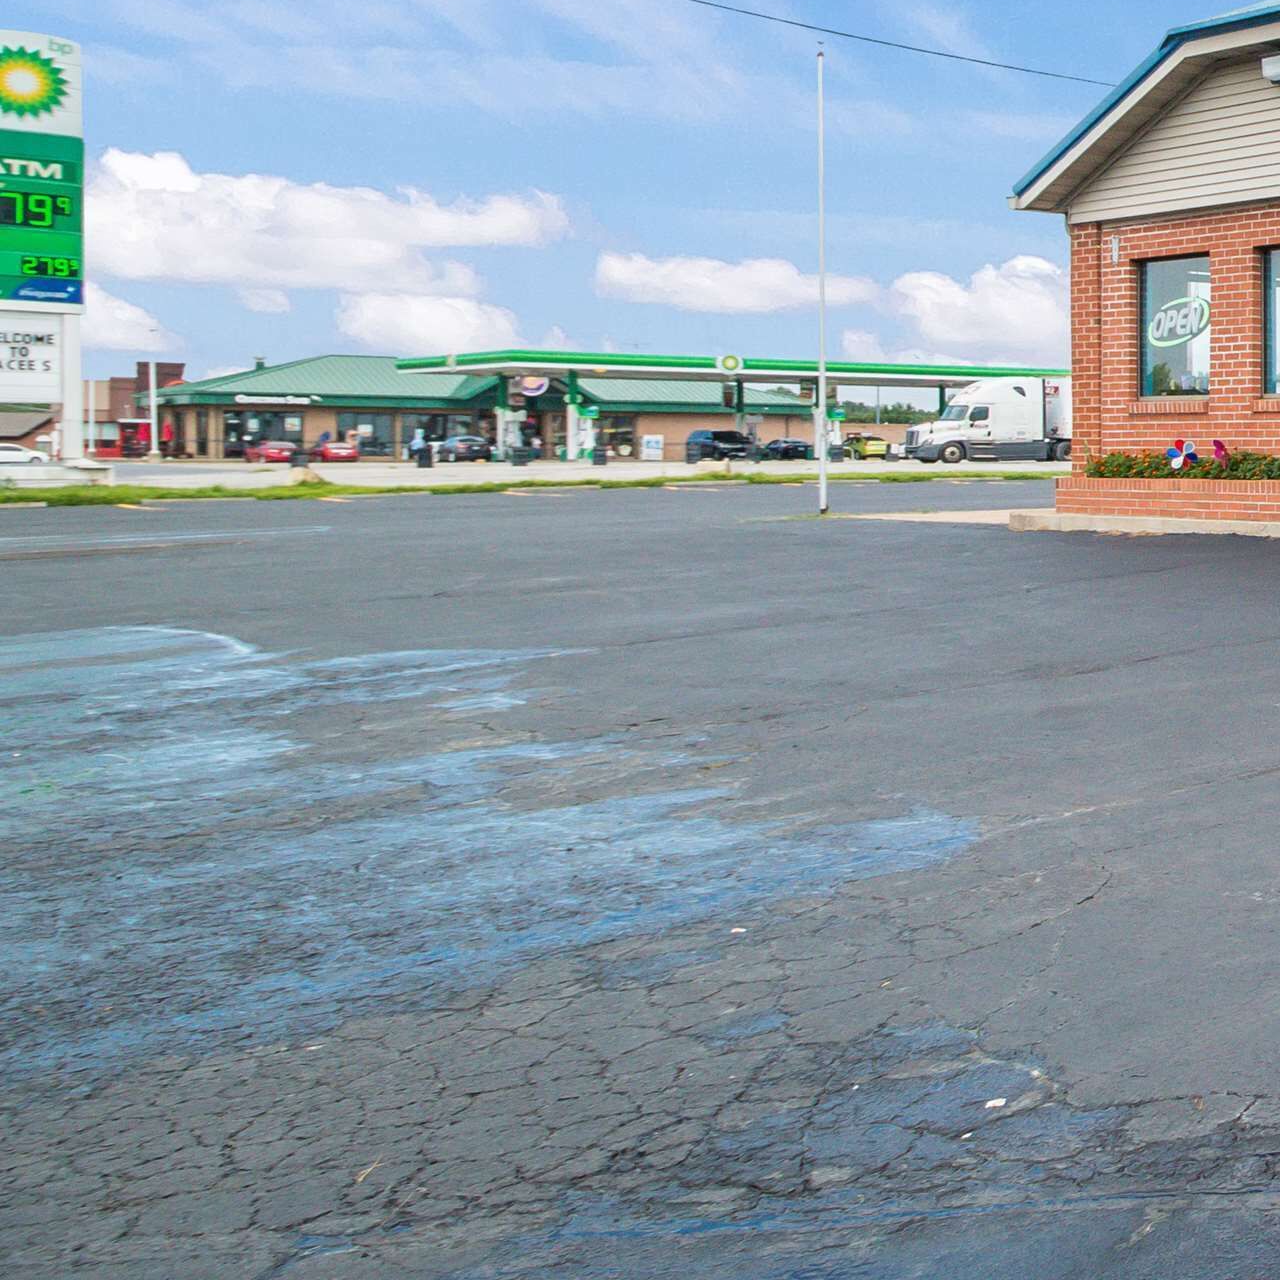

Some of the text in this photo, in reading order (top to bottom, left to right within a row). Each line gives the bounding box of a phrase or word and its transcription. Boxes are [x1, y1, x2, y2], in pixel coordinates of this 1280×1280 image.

[49, 38, 74, 57] bp
[1152, 302, 1201, 339] OPEN
[9, 346, 29, 357] TO
